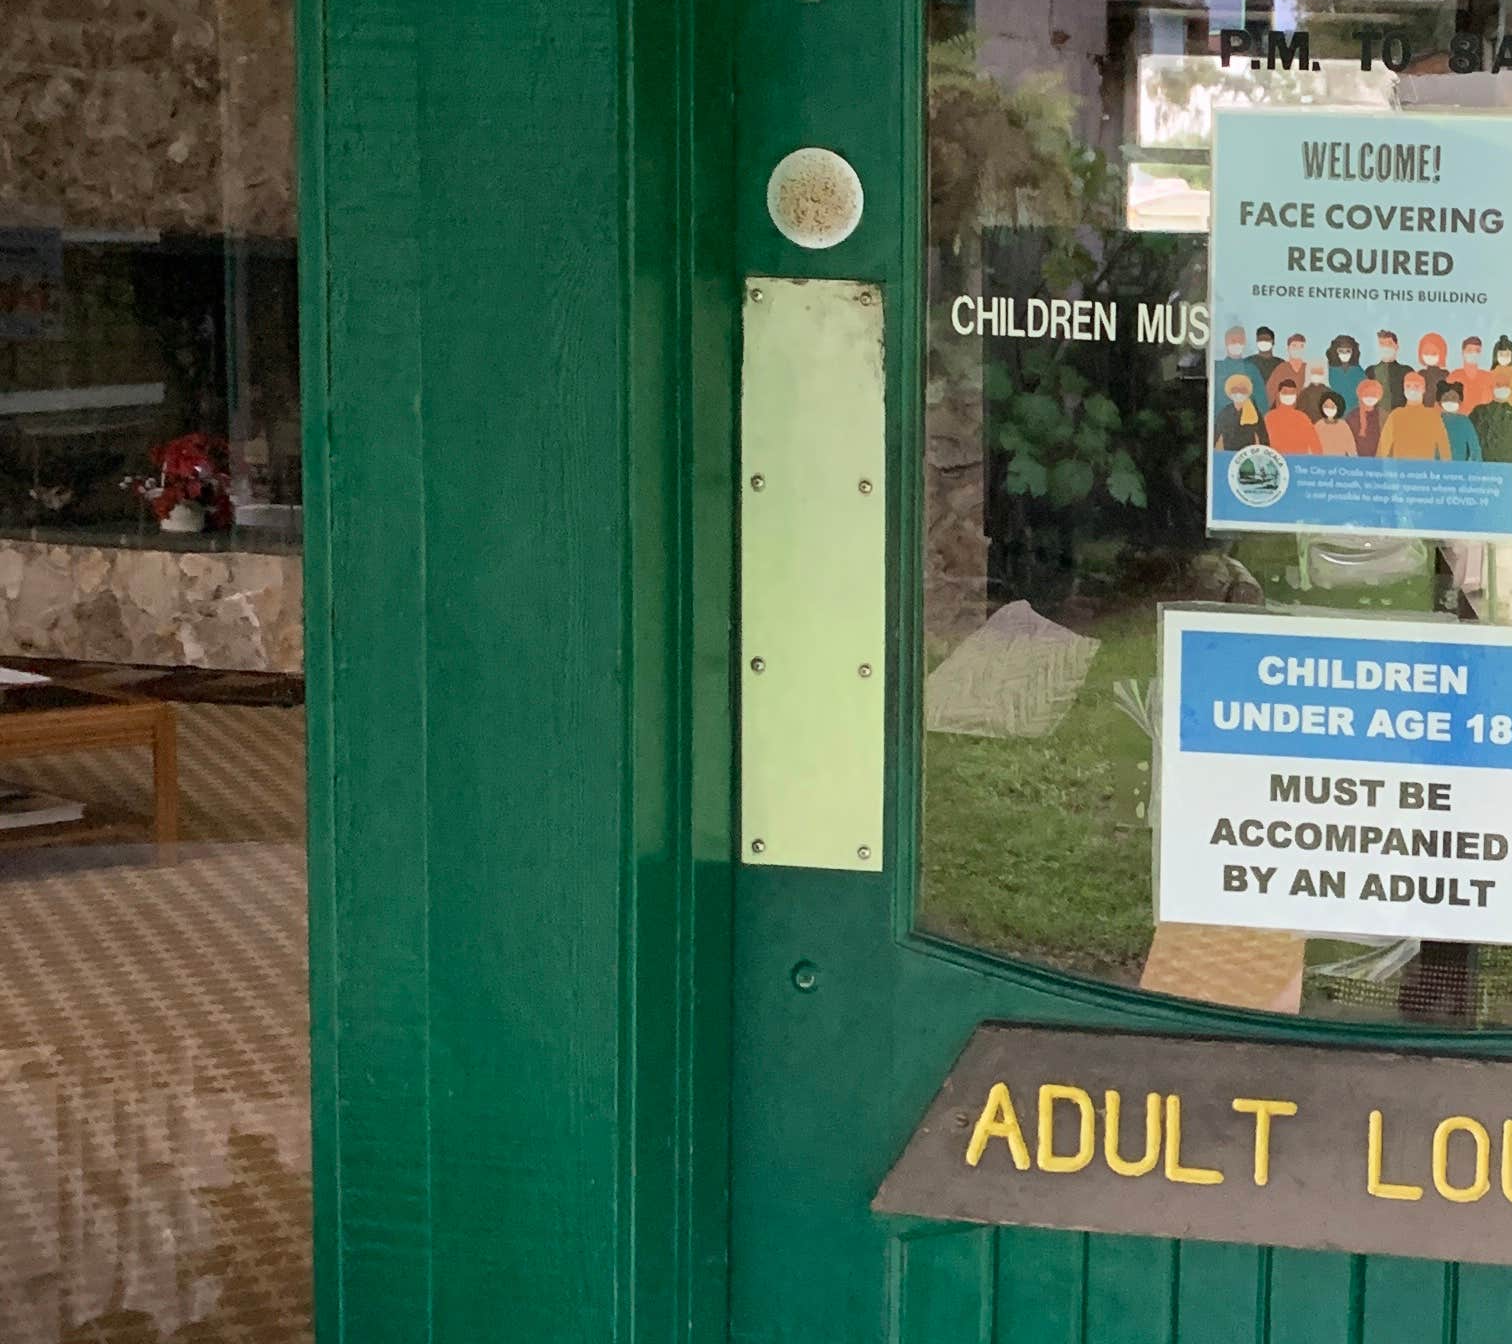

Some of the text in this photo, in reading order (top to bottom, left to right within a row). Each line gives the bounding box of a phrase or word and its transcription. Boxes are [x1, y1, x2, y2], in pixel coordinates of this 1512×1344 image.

[1220, 28, 1321, 73] P.M.
[1353, 30, 1412, 74] TO
[1301, 140, 1443, 184] WELCOME!
[1239, 200, 1505, 235] FACE COVERING
[1286, 245, 1455, 277] REQUIRED
[1251, 284, 1489, 305] BEFORE ENTERING THIS BUILDING
[951, 294, 1118, 343] CHILDREN
[1137, 302, 1210, 348] MUS
[1257, 655, 1468, 695] CHILDREN
[1212, 700, 1355, 737] UNDER
[1366, 708, 1452, 743] AGE
[1269, 774, 1453, 812] MUST BE
[1209, 817, 1510, 862] ACCOMPANIED
[1222, 863, 1497, 908] BY AN ADULT
[965, 1080, 1298, 1187] ADULT
